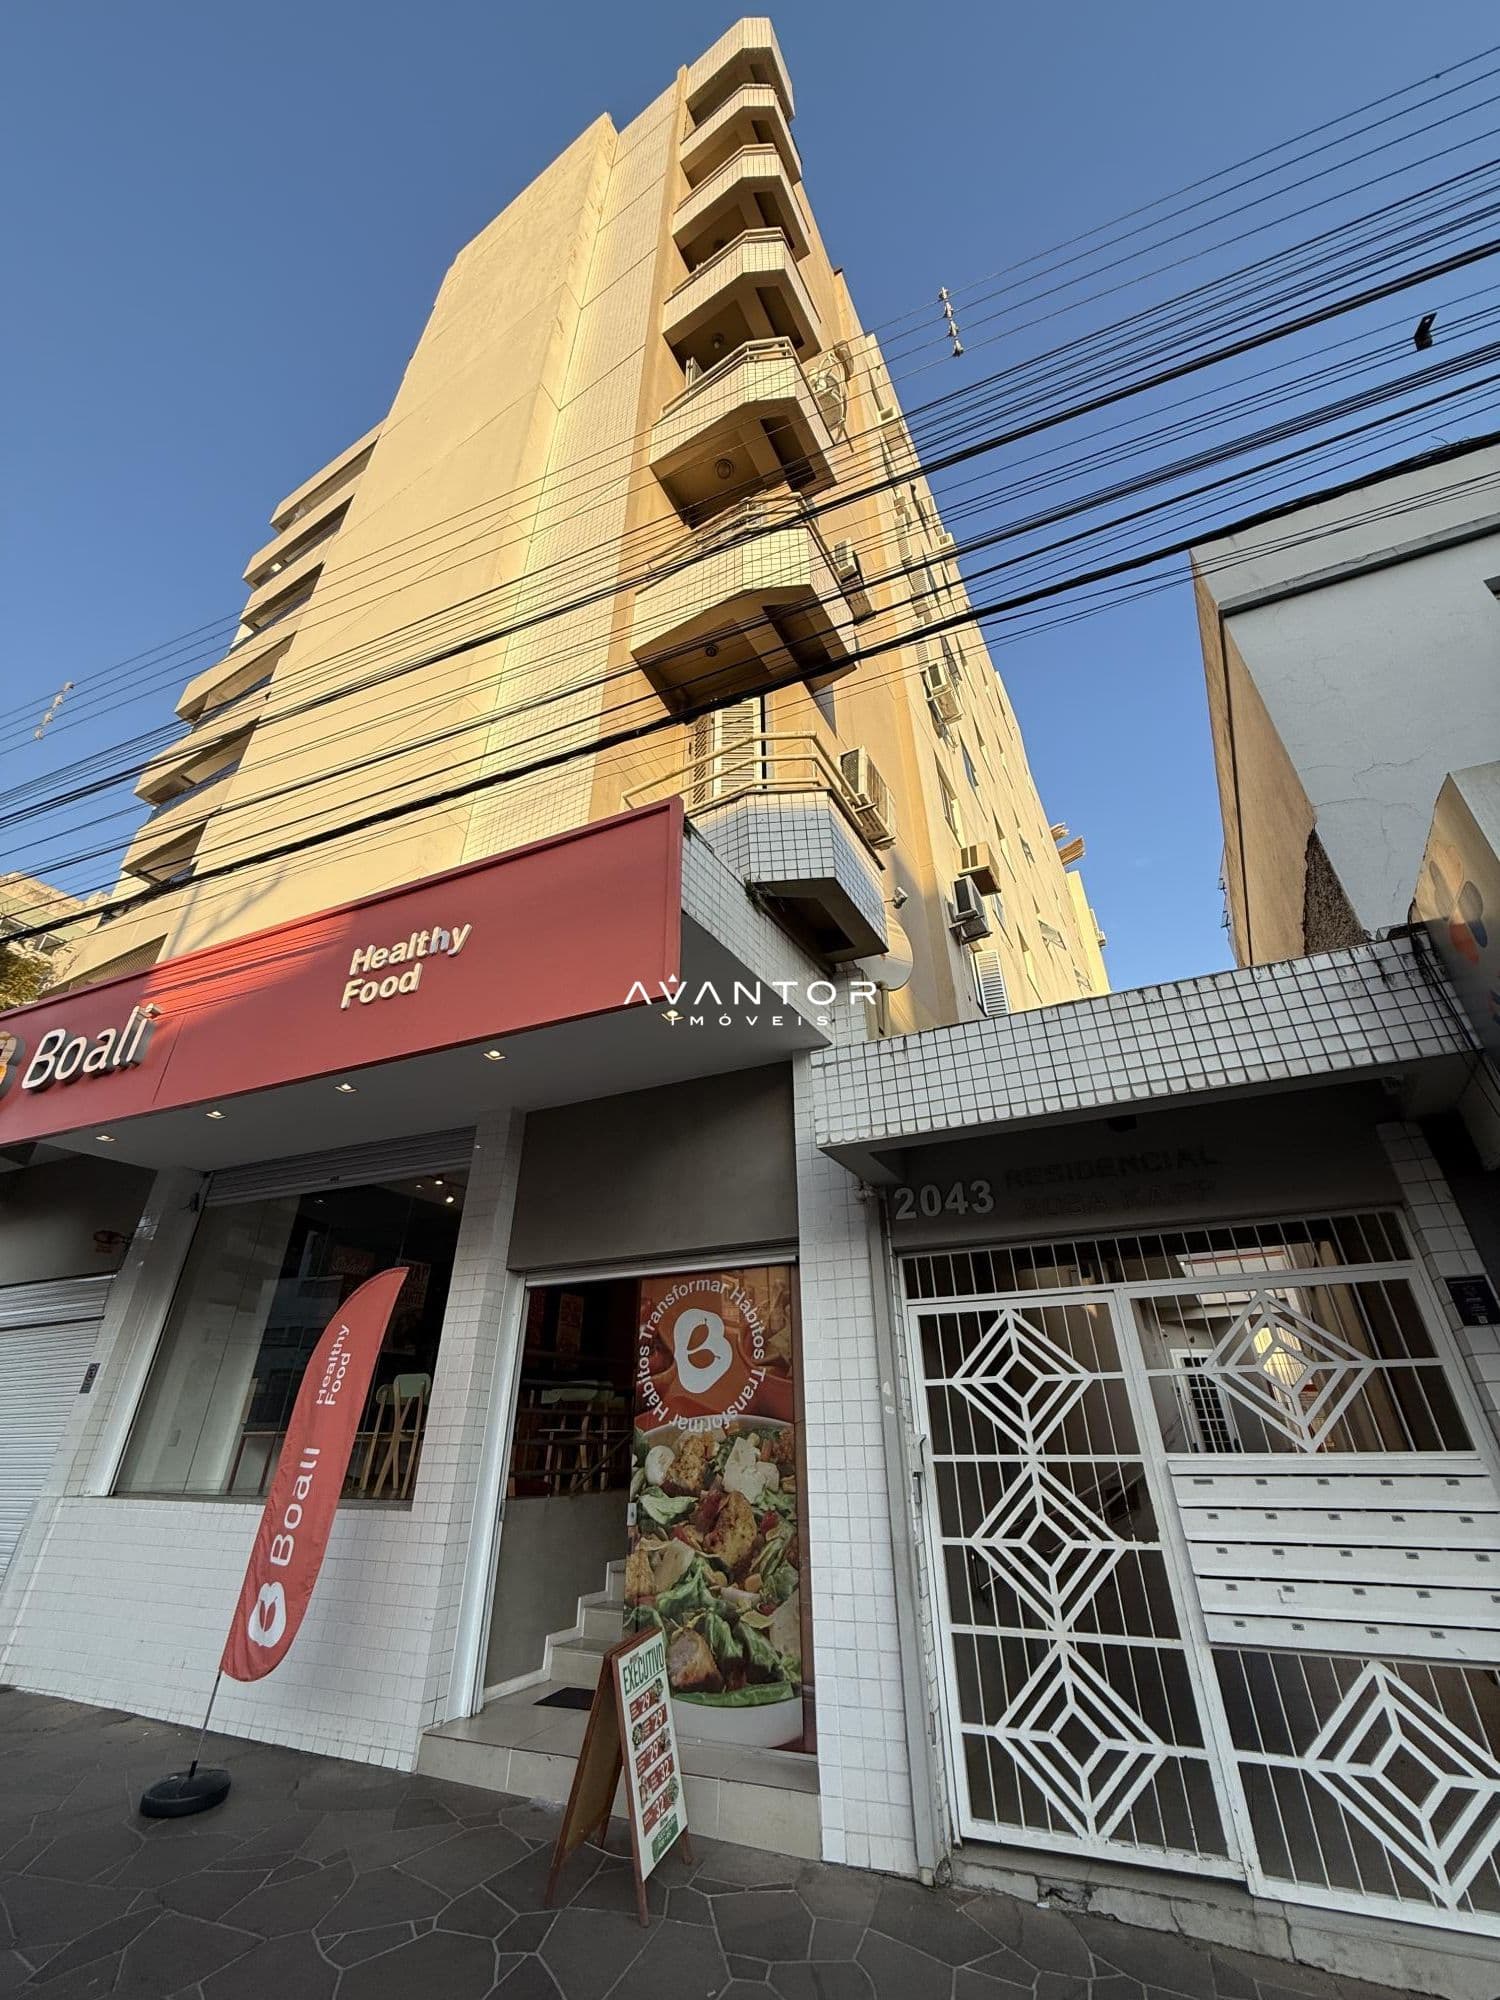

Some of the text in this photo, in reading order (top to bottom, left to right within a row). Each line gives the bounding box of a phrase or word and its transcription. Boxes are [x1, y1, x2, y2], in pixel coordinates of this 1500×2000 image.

[349, 923, 473, 977] Healthy
[340, 962, 424, 1010] Food
[21, 1002, 160, 1092] Boali
[893, 1179, 996, 1221] 2043
[638, 1279, 766, 1361] Transformar Hábitos
[316, 1323, 351, 1406] Healthy
[324, 1351, 352, 1407] Food
[636, 1345, 670, 1422] Hábitos
[668, 1367, 768, 1433] Transformar
[623, 1642, 665, 1696] EXECUTIVO
